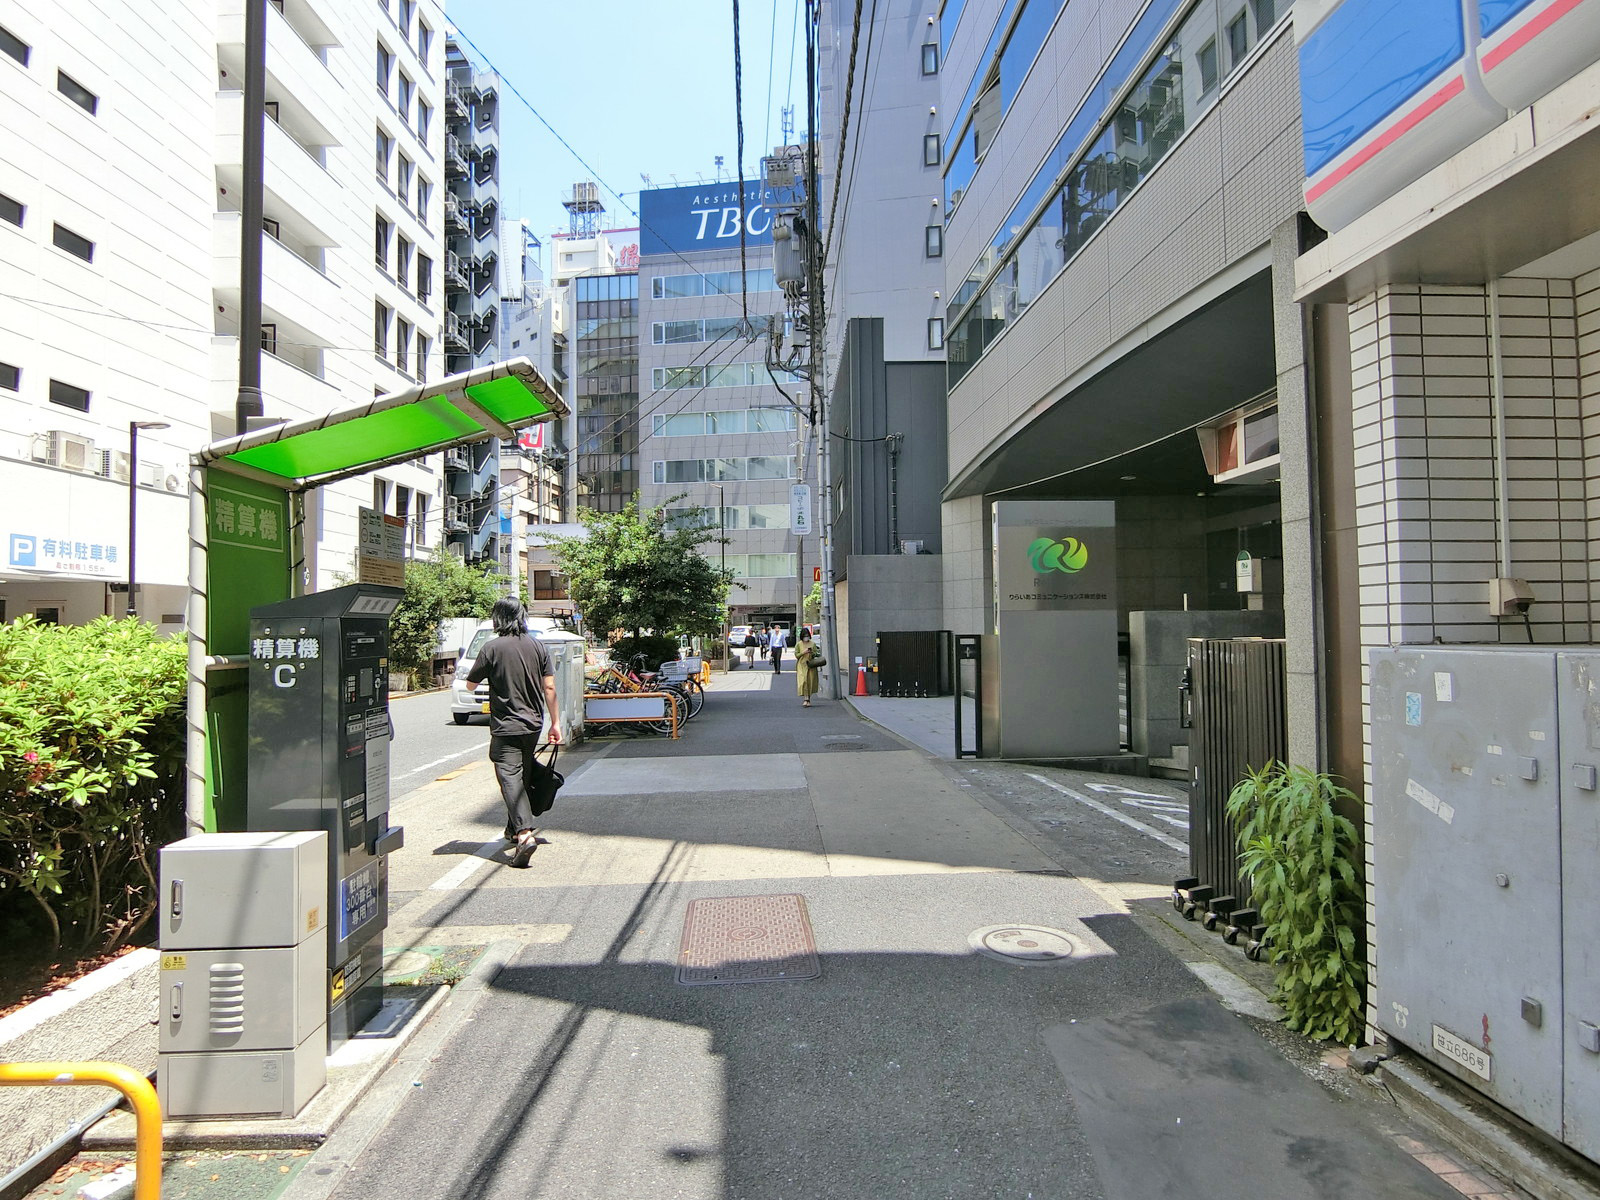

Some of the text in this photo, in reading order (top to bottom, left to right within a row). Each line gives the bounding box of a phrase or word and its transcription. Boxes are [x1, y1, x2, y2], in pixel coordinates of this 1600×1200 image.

[691, 204, 771, 240] TBC
[215, 497, 278, 542] 精算機
[42, 537, 118, 563] 有料駐車場
[253, 637, 320, 660] 精算機
[274, 663, 296, 688] C
[351, 903, 367, 926] 専用
[1437, 1034, 1486, 1070] 笹立686号
